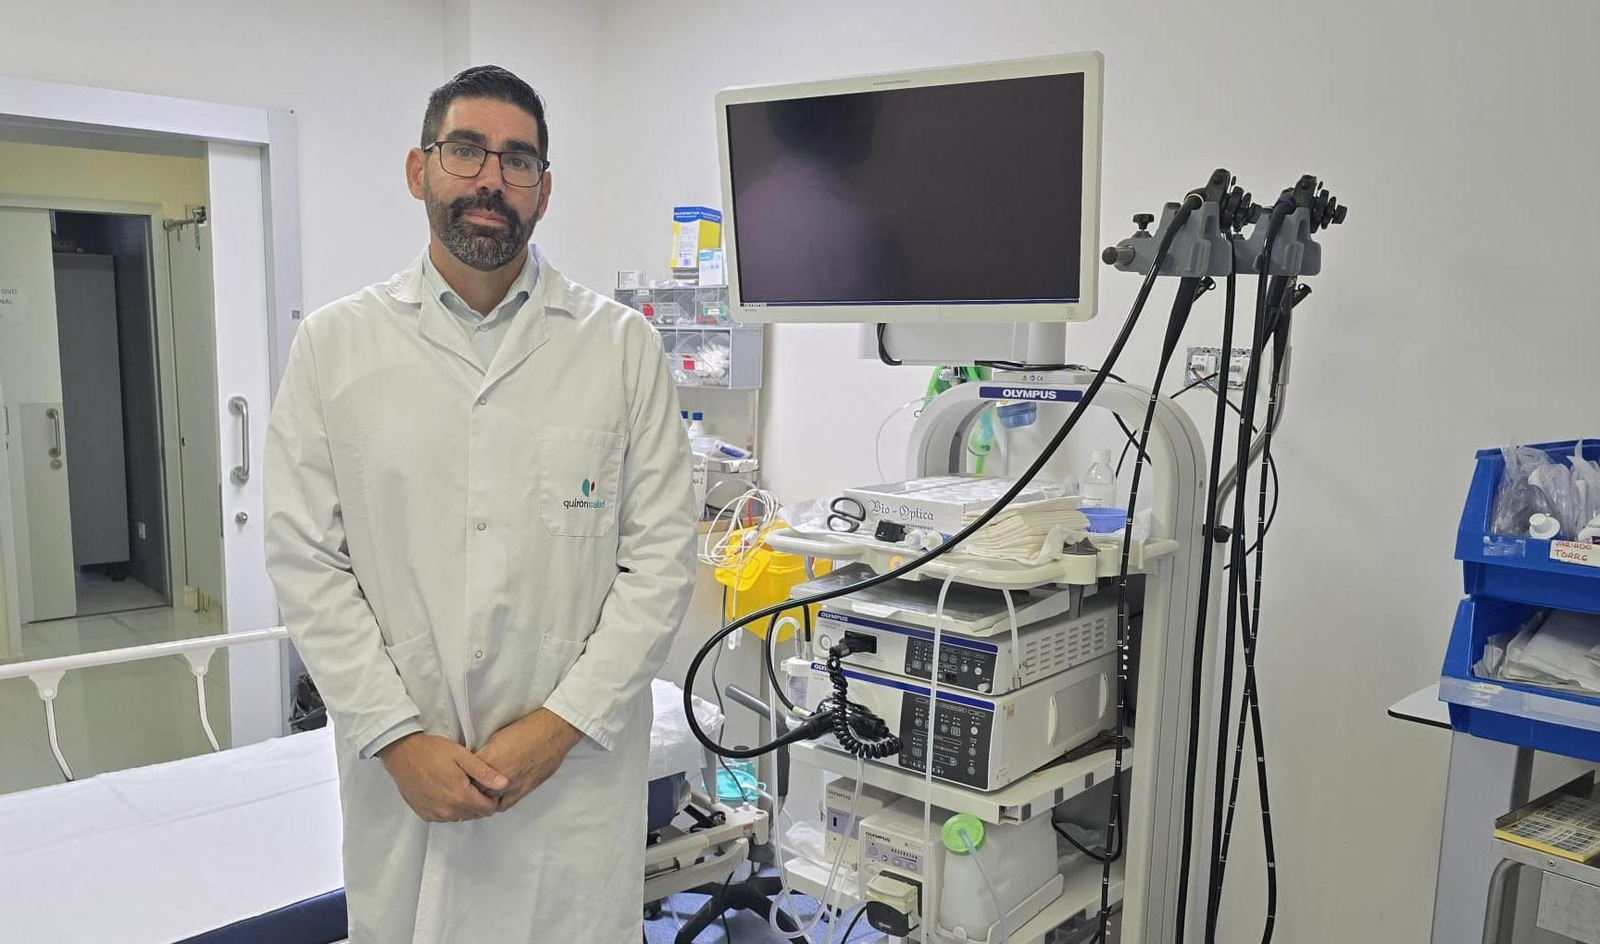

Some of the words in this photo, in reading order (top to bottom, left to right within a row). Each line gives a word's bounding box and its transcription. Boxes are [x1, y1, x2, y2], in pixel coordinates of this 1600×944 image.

[1002, 388, 1057, 400] OLYMPUS
[821, 611, 849, 622] OLYMPUS
[865, 831, 891, 843] OLYMPUS
